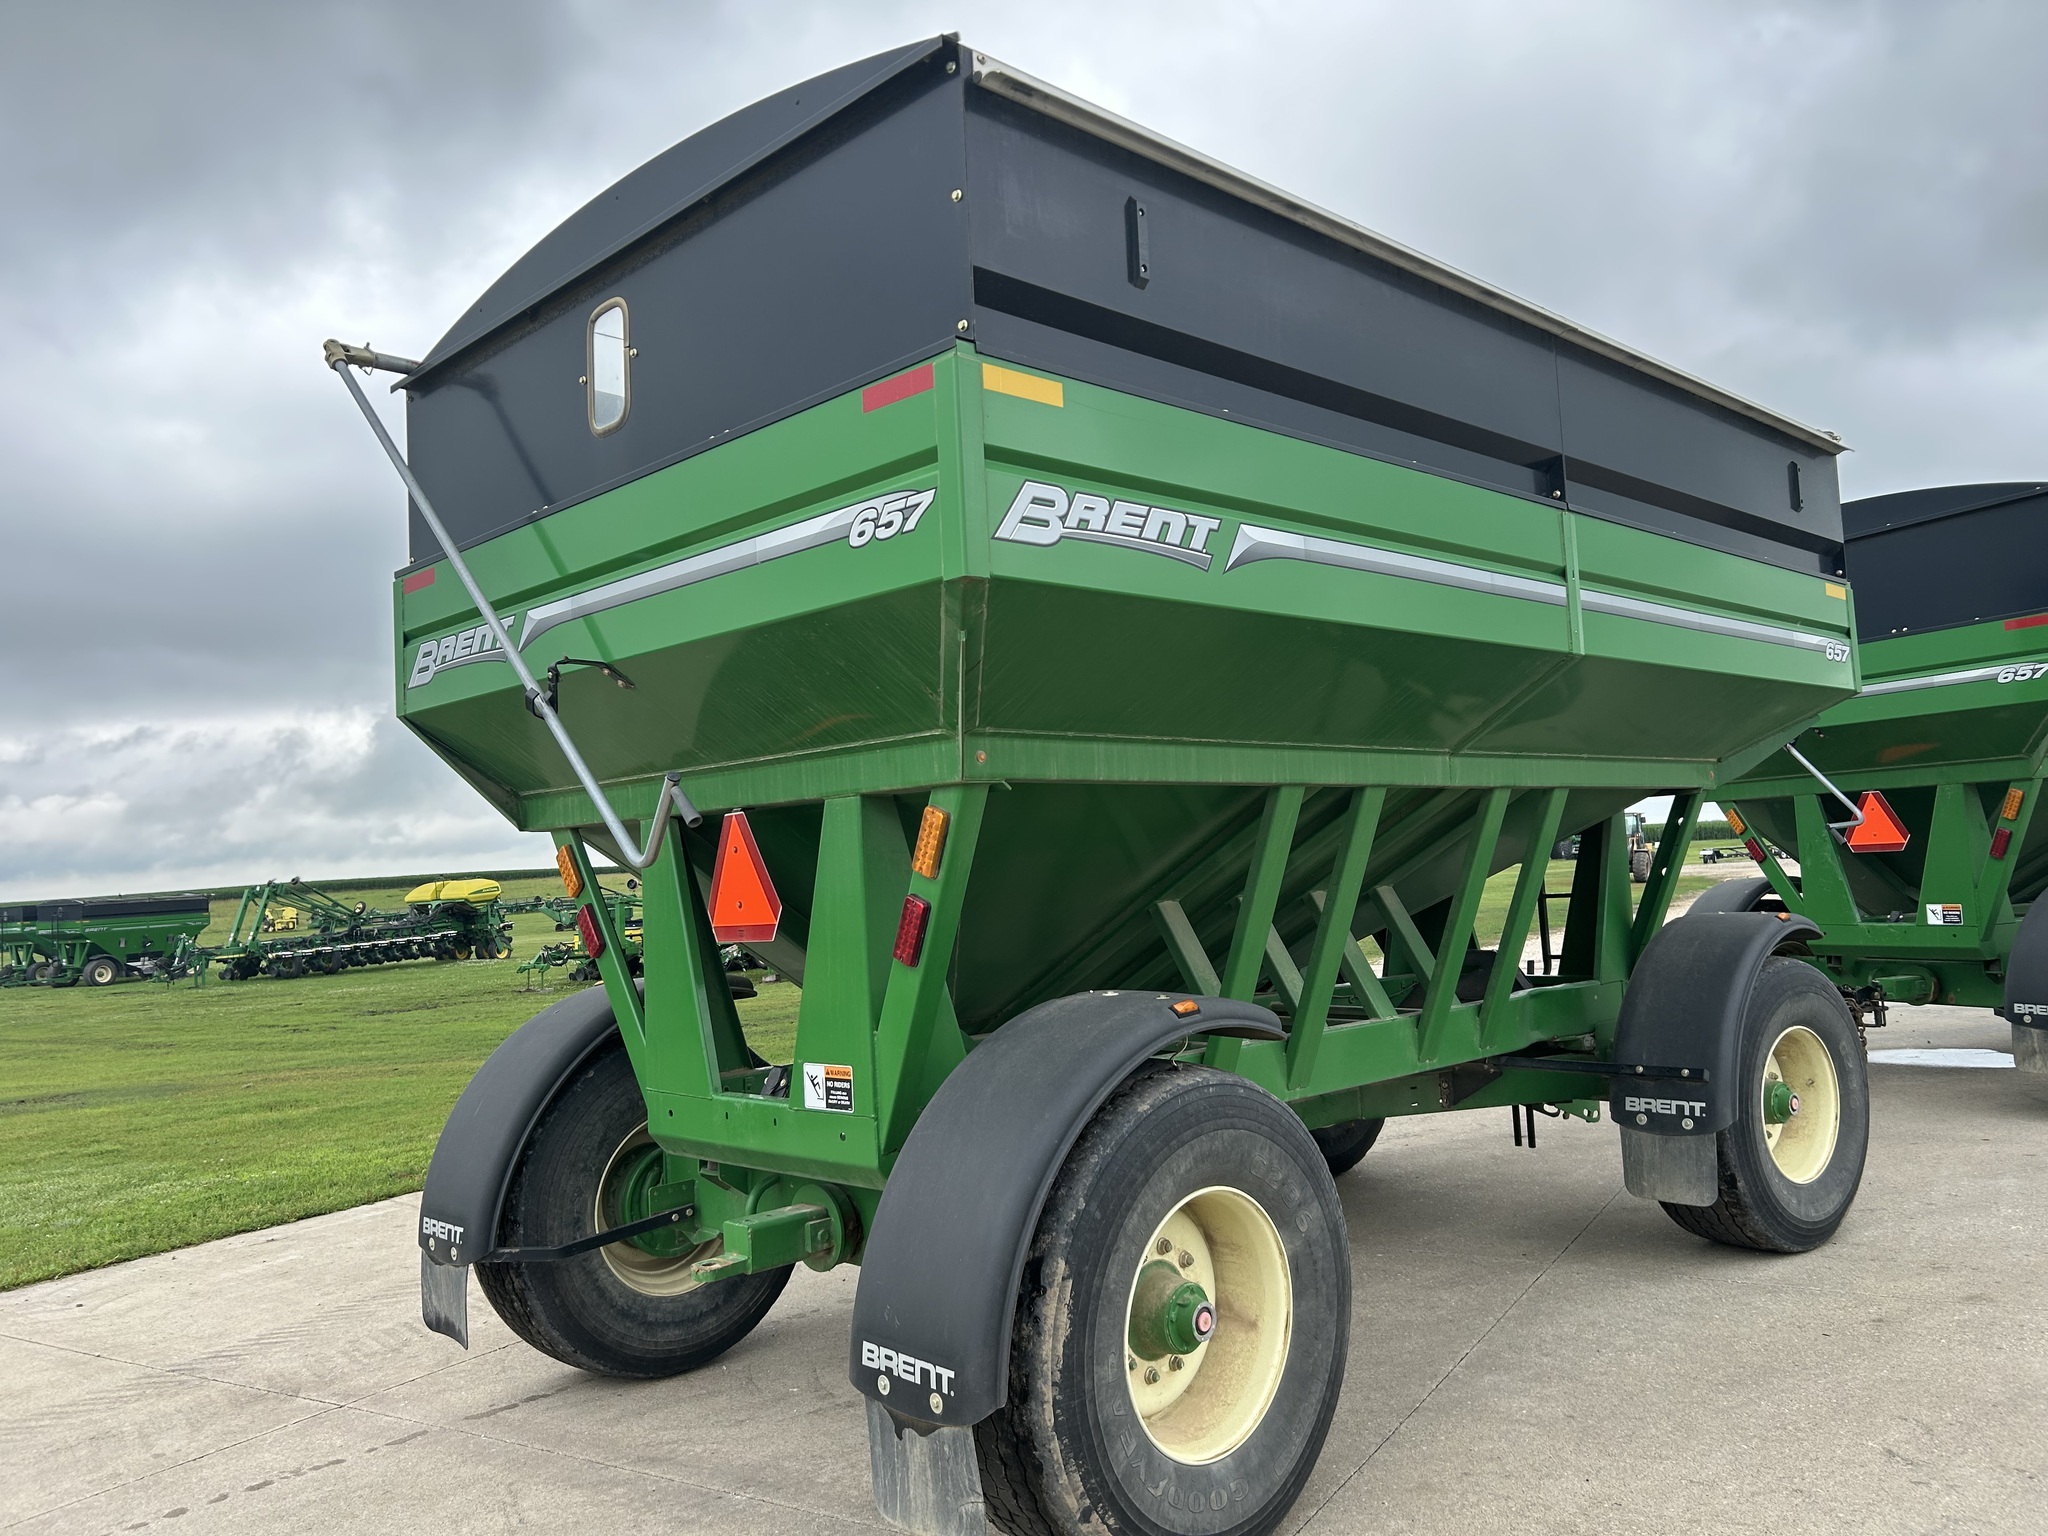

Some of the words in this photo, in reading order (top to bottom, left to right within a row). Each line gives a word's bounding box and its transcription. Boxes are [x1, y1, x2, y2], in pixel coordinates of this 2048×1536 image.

[848, 487, 937, 549] 657
[992, 479, 1222, 552] BRENT
[1826, 642, 1850, 663] 657
[1997, 663, 2048, 684] 657
[2013, 1003, 2048, 1015] BRE
[1625, 1096, 1706, 1117] BRENT
[423, 1216, 463, 1244] BRENT
[862, 1340, 955, 1396] BRENT
